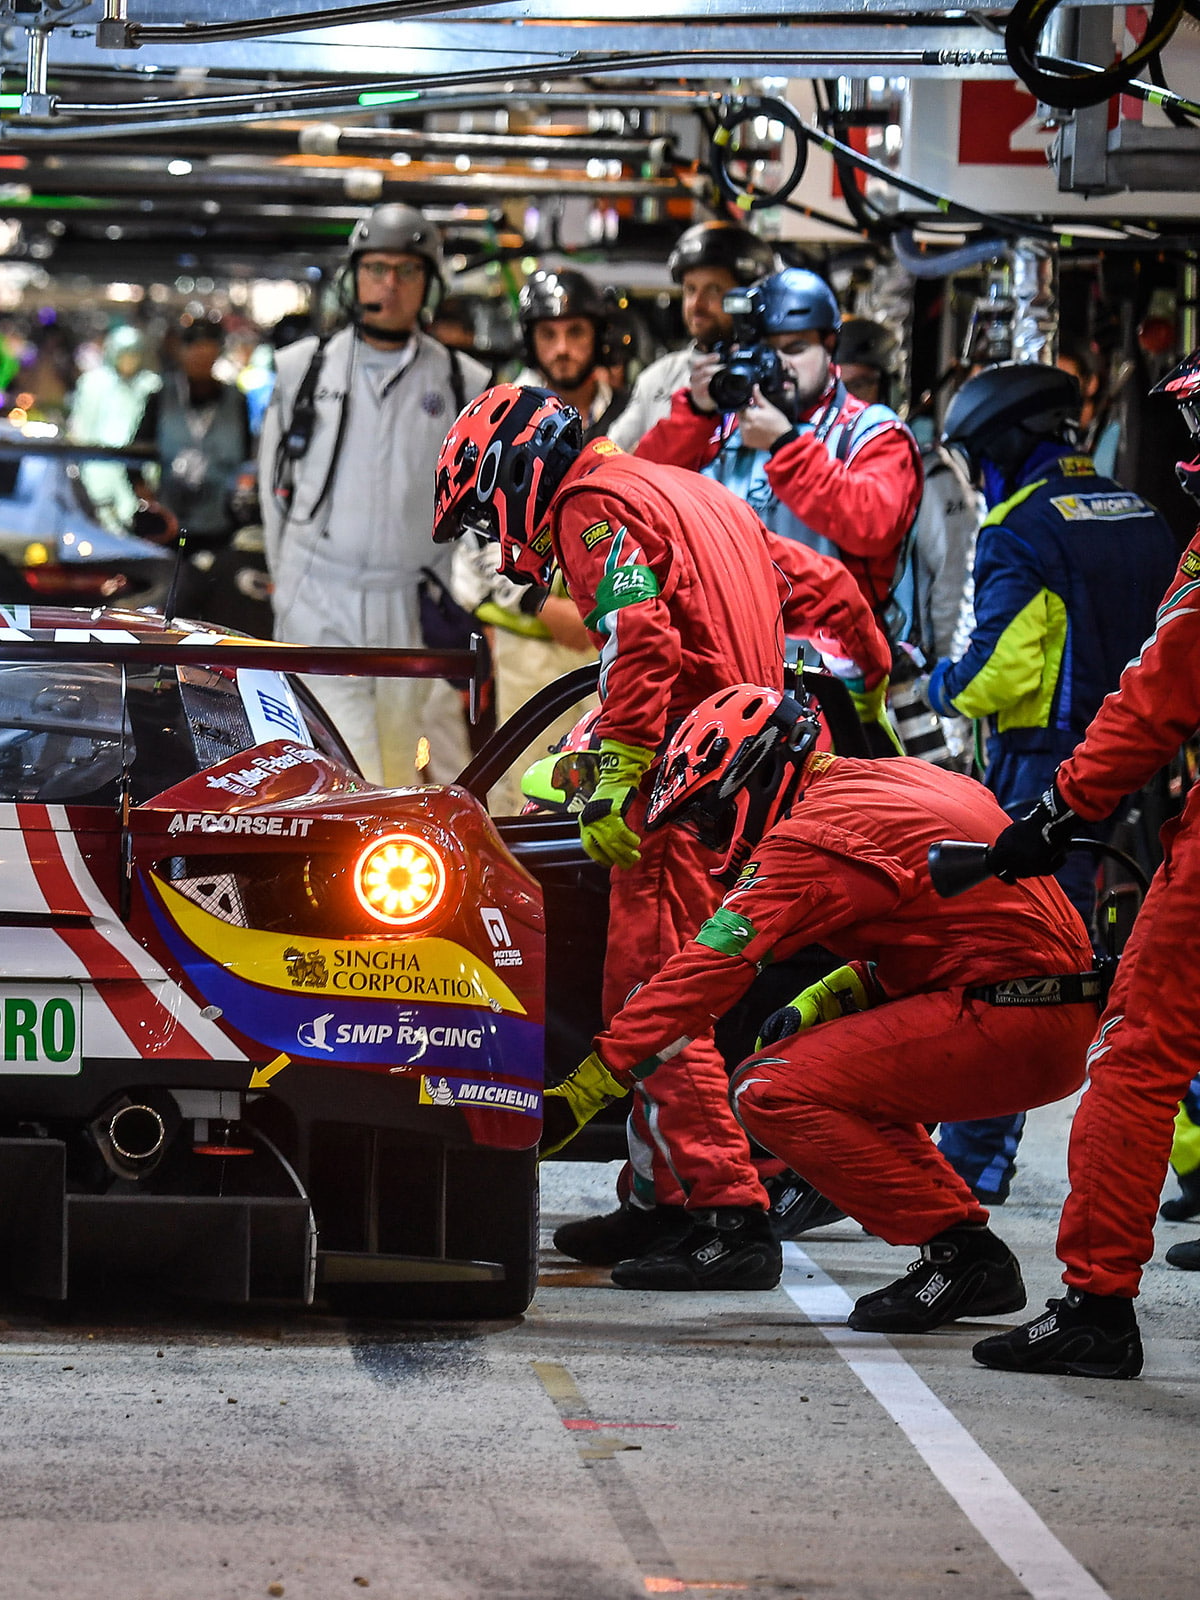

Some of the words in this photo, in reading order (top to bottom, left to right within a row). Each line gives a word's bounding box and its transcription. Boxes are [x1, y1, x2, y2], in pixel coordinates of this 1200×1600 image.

[585, 524, 609, 545] OMP
[257, 689, 302, 740] IHI
[167, 813, 314, 837] AFCORSE.IT
[333, 949, 421, 972] SINGHA
[333, 971, 484, 999] CORPORATION
[336, 1023, 392, 1044] SMP
[397, 1025, 483, 1049] RACING
[458, 1084, 539, 1110] MICHELIN
[775, 1187, 797, 1213] OMP
[697, 1241, 723, 1261] OMP
[920, 1274, 944, 1302] OMP
[1028, 1317, 1057, 1339] OMP
